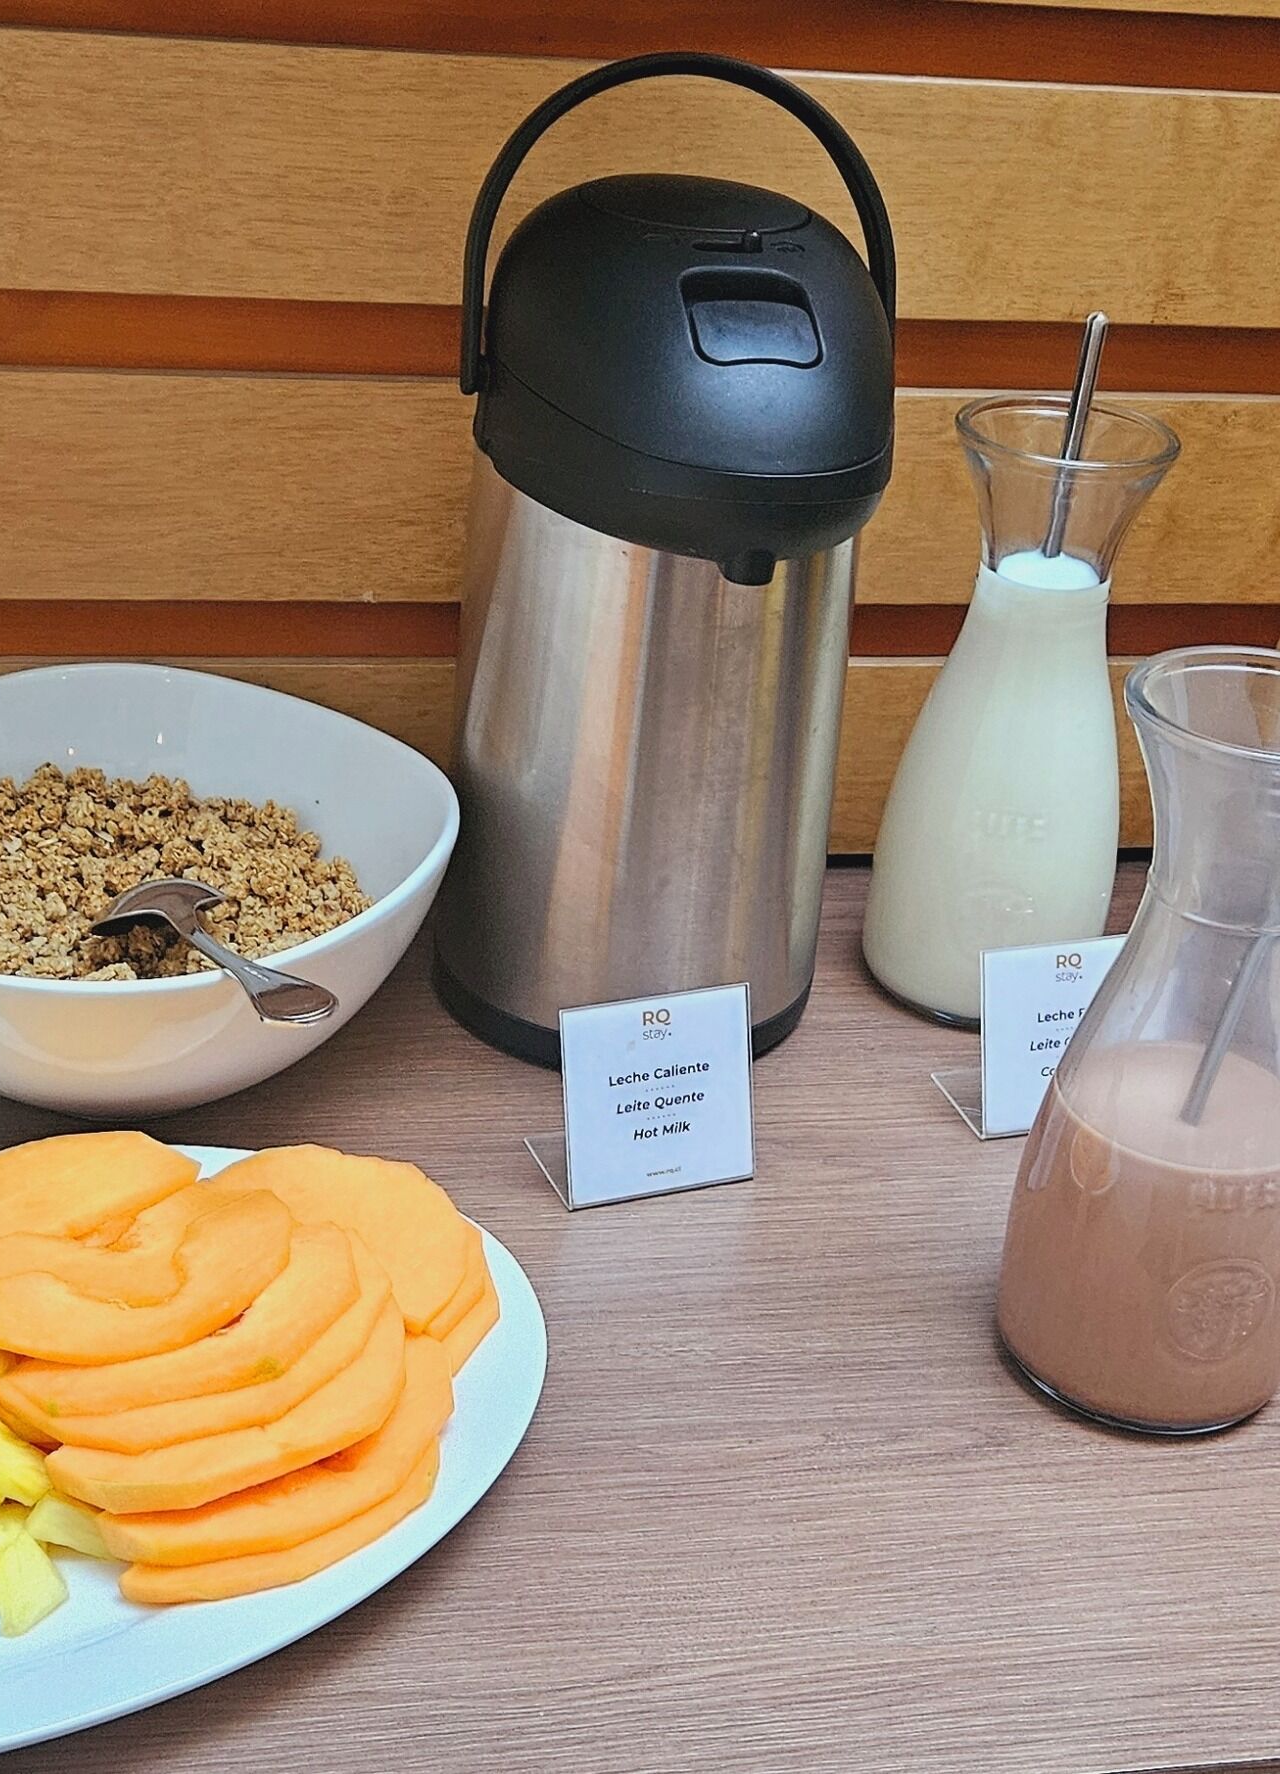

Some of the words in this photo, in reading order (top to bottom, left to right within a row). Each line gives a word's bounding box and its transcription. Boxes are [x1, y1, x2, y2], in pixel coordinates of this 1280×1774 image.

[1056, 953, 1082, 969] RQ
[642, 1008, 671, 1026] RQ
[1037, 1009, 1074, 1023] Leche
[1030, 1036, 1061, 1051] Leite
[608, 1071, 650, 1087] Leche
[654, 1061, 710, 1080] Caliente
[616, 1099, 651, 1115] Leite
[655, 1091, 705, 1111] Quente
[633, 1126, 658, 1141] Hot
[662, 1120, 691, 1135] Milk
